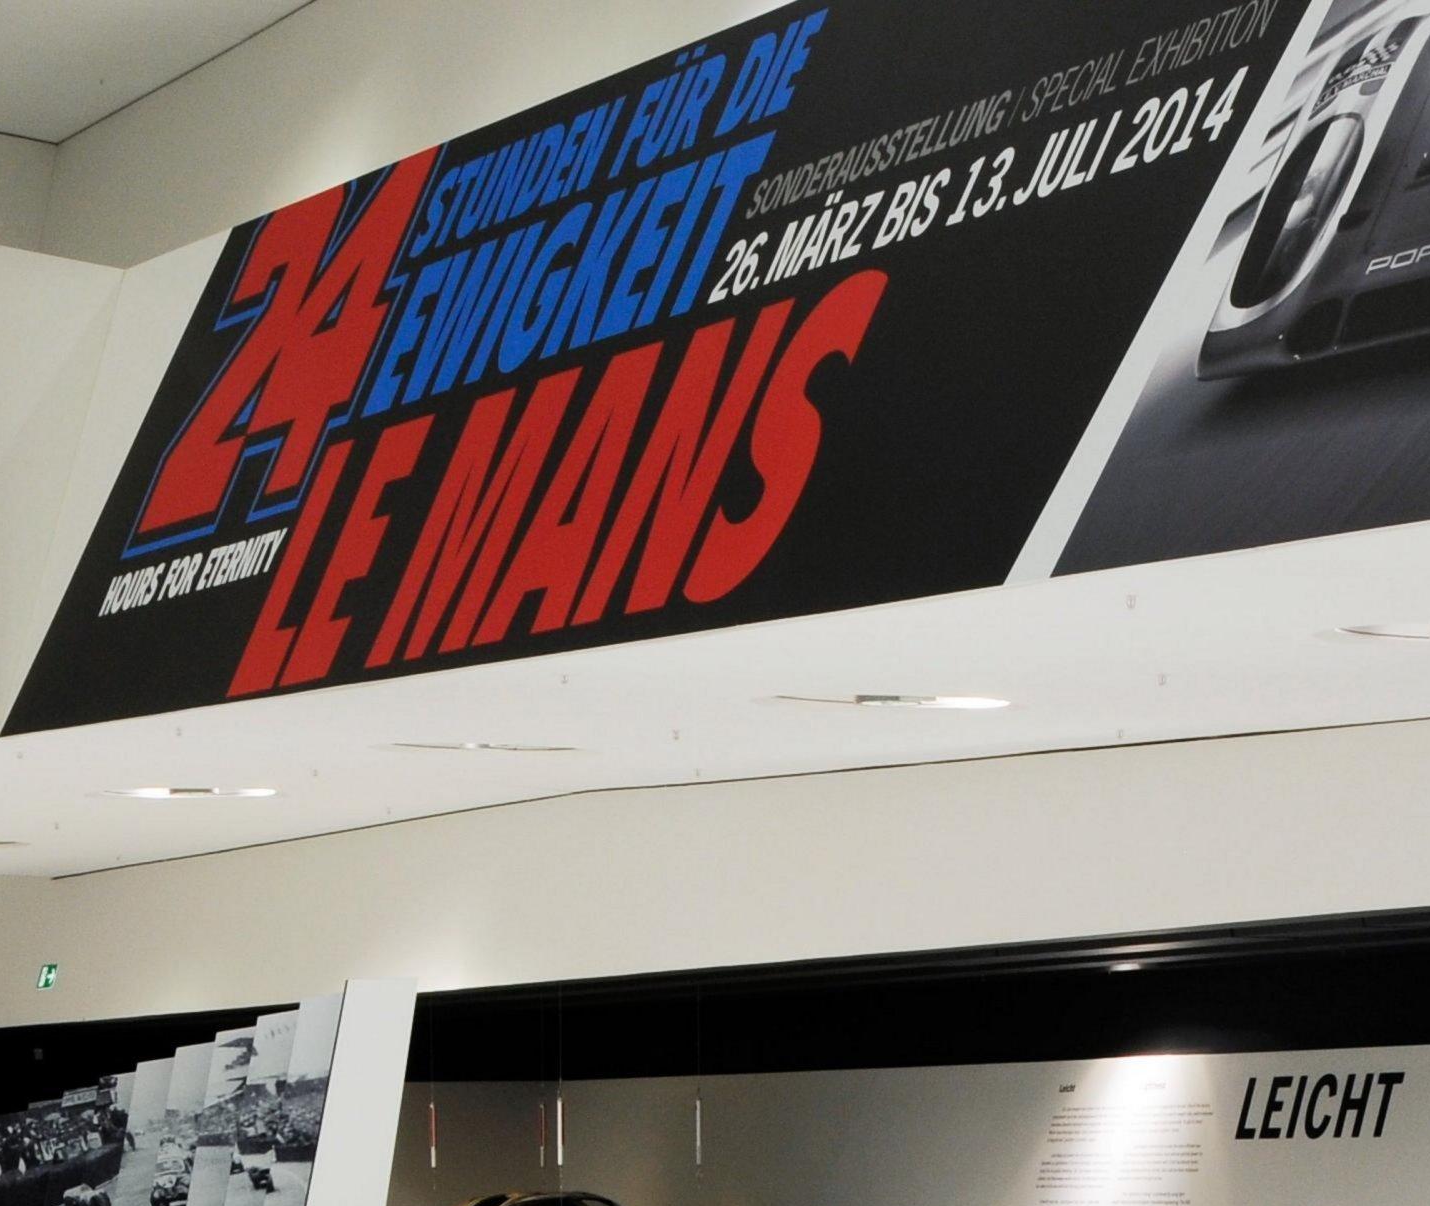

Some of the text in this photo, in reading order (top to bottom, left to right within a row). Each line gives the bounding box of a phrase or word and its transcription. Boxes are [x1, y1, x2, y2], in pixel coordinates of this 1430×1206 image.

[409, 8, 829, 258] STUNDEN FÜR DIE
[707, 230, 769, 304] 26.
[763, 186, 886, 286] MÄRZ
[872, 167, 951, 250] BIS
[944, 146, 1016, 227] 13.
[1012, 110, 1123, 206] JULI
[1110, 66, 1249, 174] 2014
[746, 89, 1012, 220] SONDERAUSSTELLUNG
[1022, 49, 1125, 122] SPECIAL
[1125, 0, 1277, 86] EXHIBITION
[138, 146, 439, 534] 24
[359, 129, 776, 419] EWIGKEIT
[99, 528, 288, 616] HOURS FOR ETERNITY
[226, 268, 889, 698] LE MANS
[1235, 1071, 1405, 1140] LEICHT
